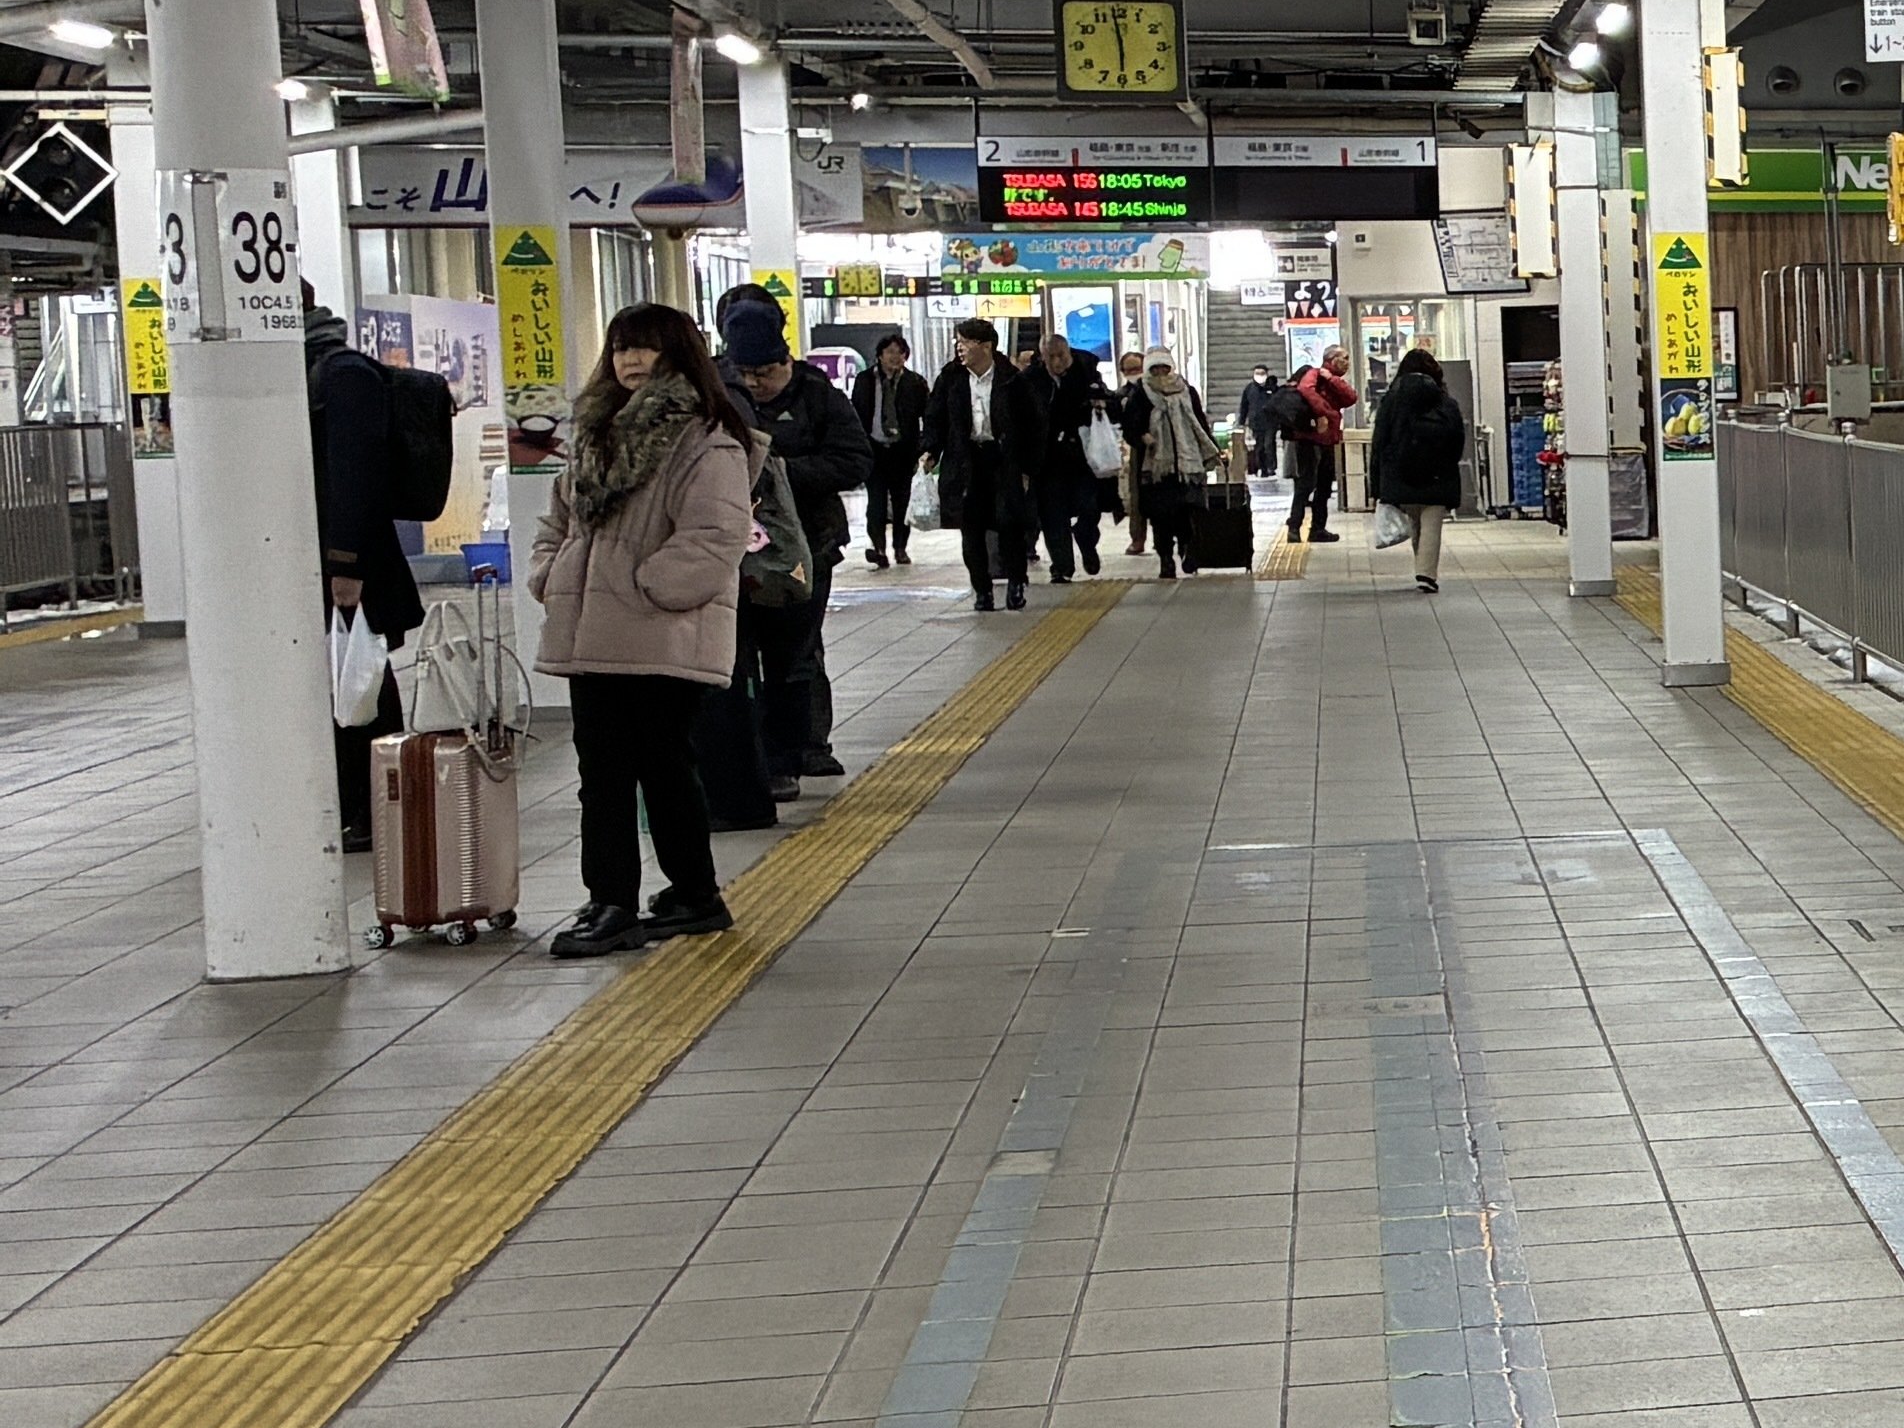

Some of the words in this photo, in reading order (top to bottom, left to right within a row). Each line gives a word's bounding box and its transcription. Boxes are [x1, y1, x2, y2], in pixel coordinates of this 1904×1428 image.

[1870, 8, 1887, 17] train
[1870, 18, 1896, 27] button
[984, 140, 1001, 162] 2
[1416, 140, 1426, 162] 1
[818, 156, 844, 169] JR
[1003, 174, 1066, 188] TSUBASA
[1099, 174, 1142, 188] 18:05
[1004, 203, 1067, 215] TSUBASA
[1100, 202, 1143, 216] 18:45
[530, 279, 555, 379] おいしい山形
[1682, 281, 1703, 373] おいしい山形
